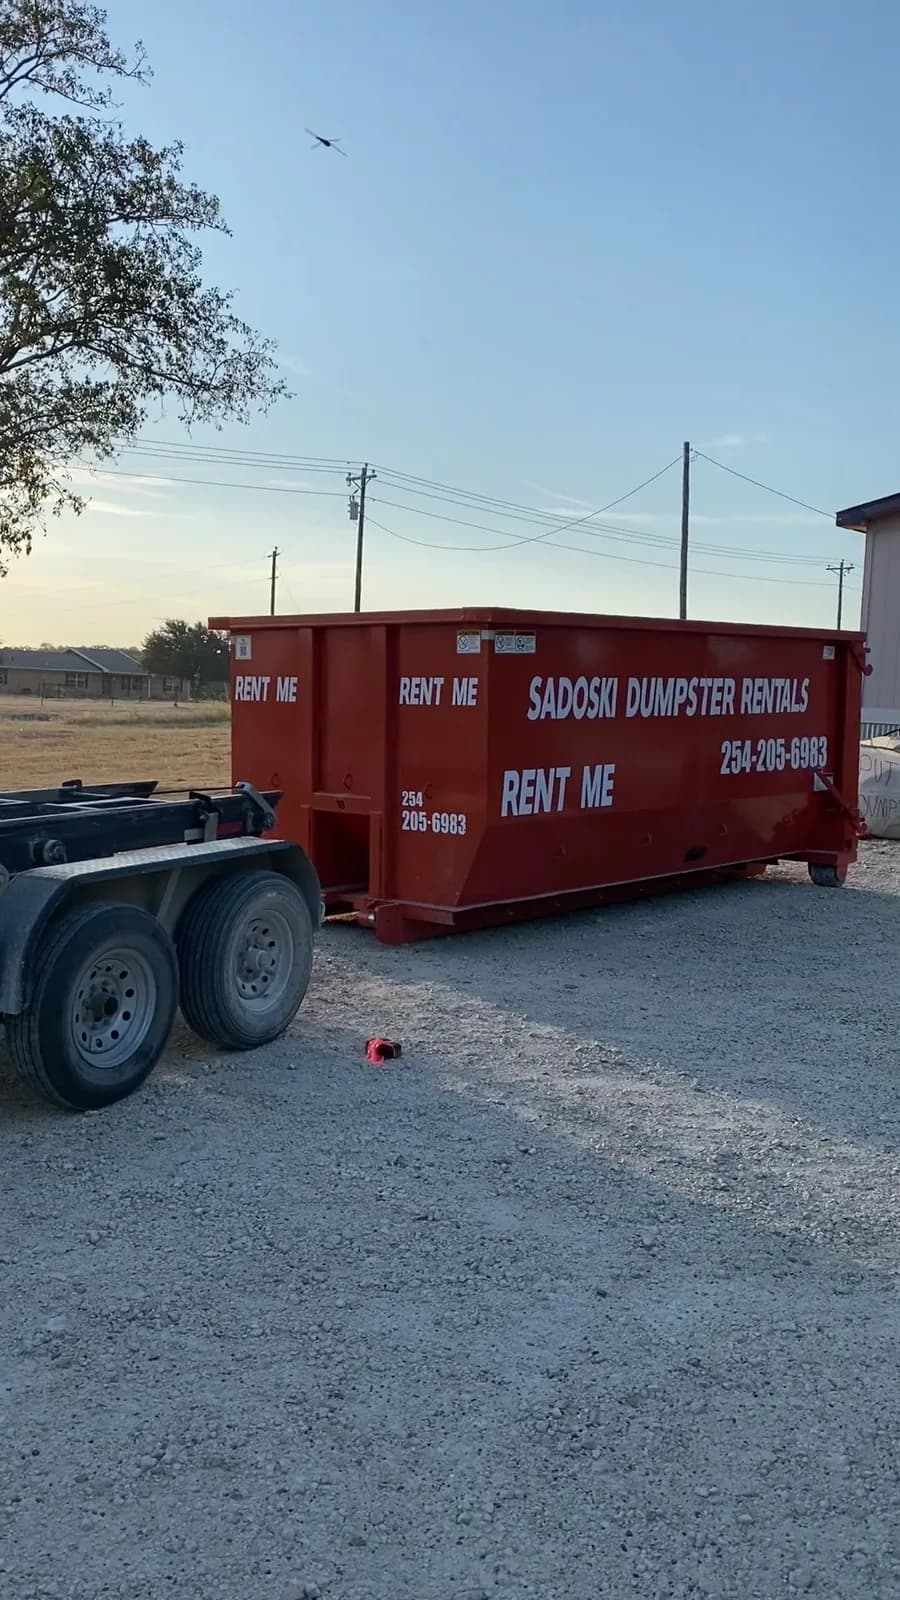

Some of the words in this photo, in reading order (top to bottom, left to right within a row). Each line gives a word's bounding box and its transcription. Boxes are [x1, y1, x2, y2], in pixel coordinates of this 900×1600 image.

[235, 676, 270, 701] RENT
[276, 677, 298, 702] ME
[399, 677, 444, 705] RENT
[452, 678, 478, 706] ME
[527, 676, 617, 720] SADOSKI
[625, 677, 736, 718] DUMPSTER
[740, 677, 810, 714] RENTALS
[720, 736, 828, 775] 254-205-6983
[402, 790, 424, 808] 254
[501, 767, 571, 817] RENT
[581, 763, 615, 809] ME
[401, 811, 467, 836] 205-6983
